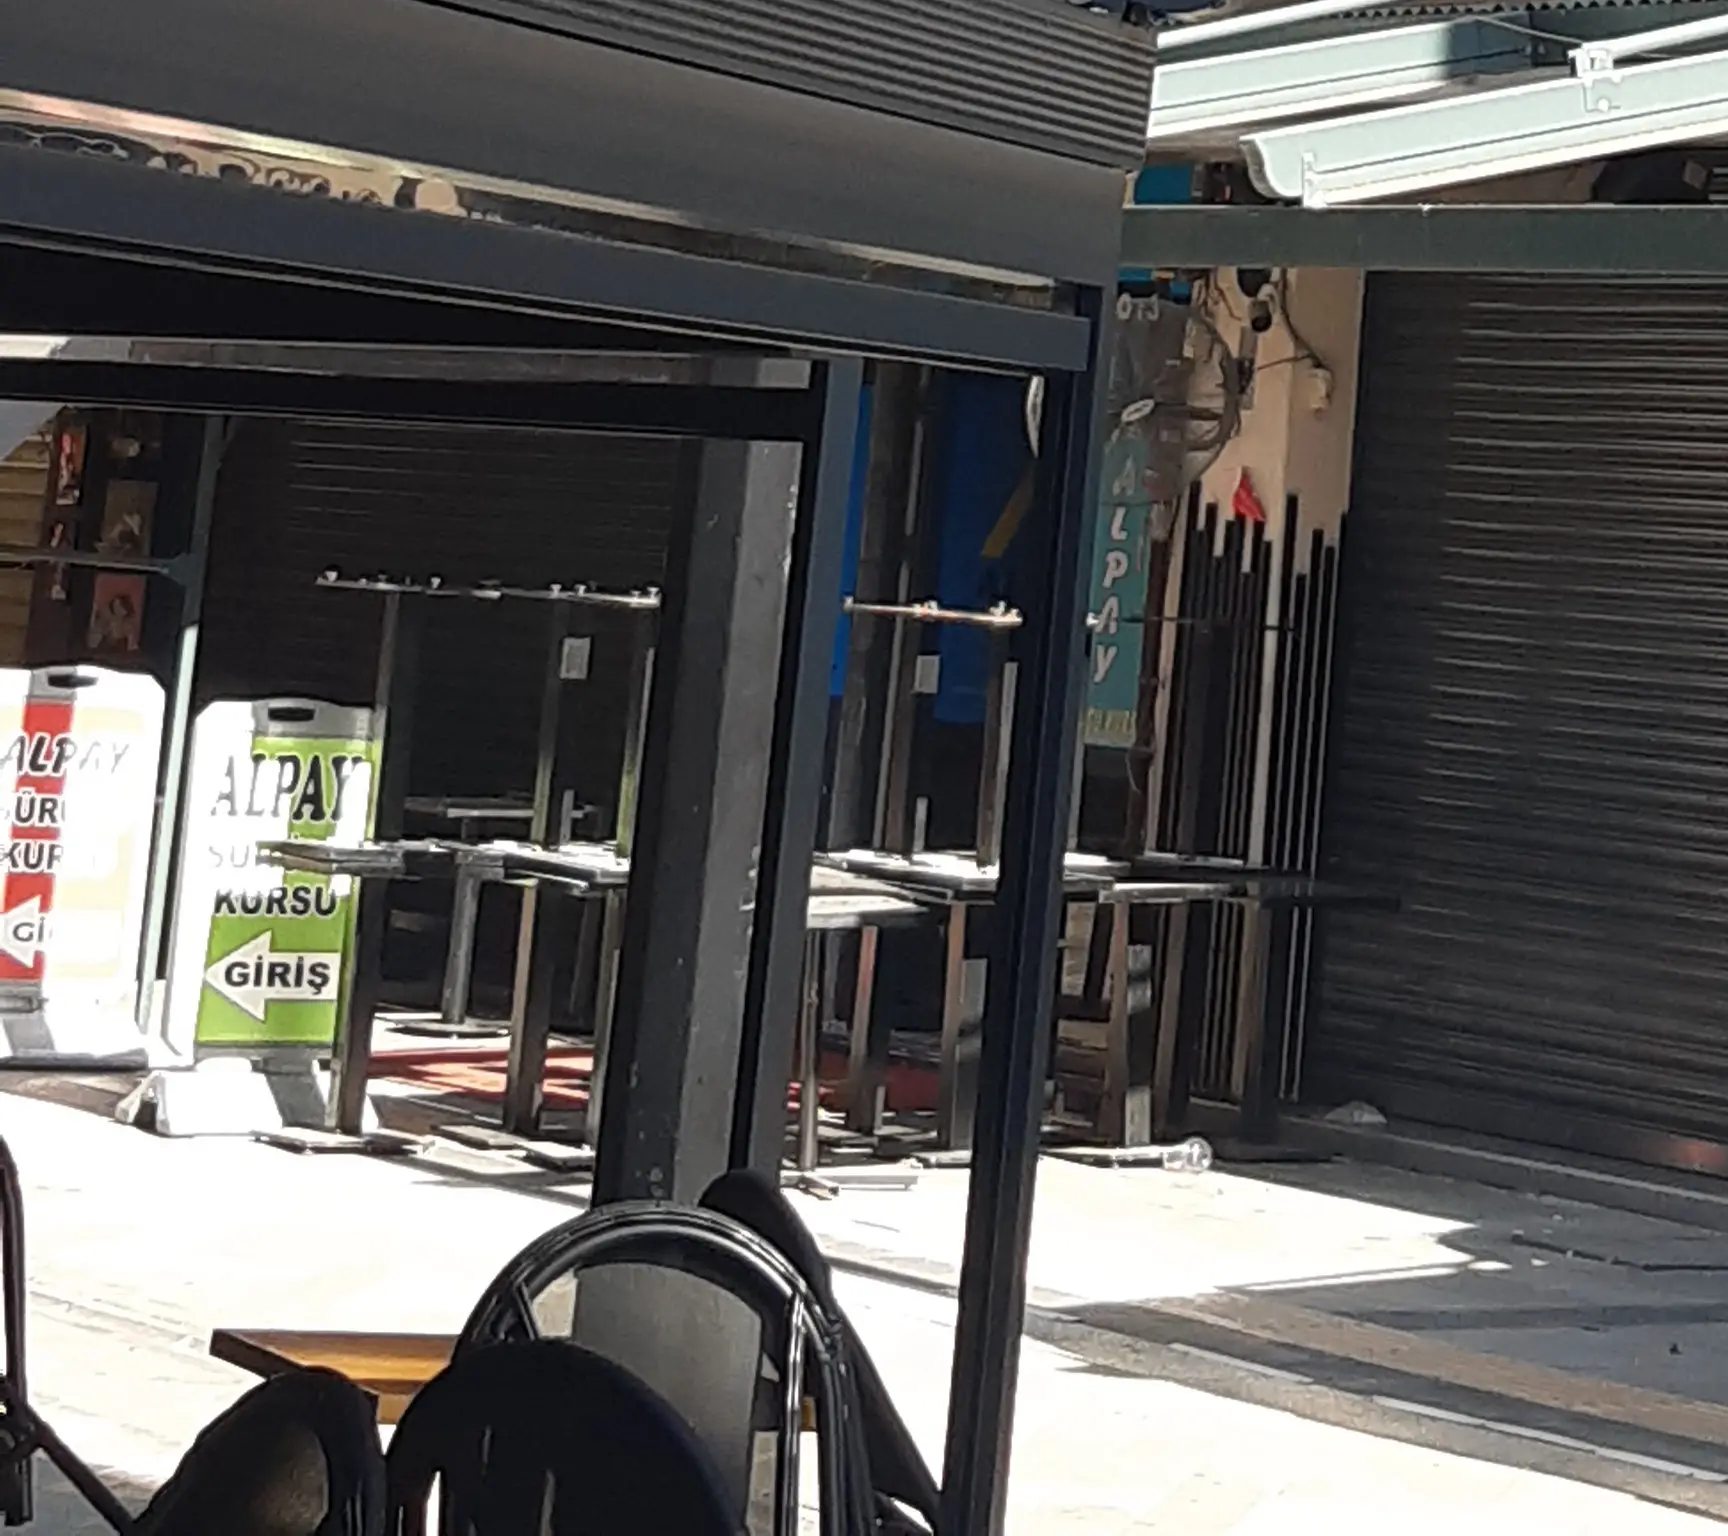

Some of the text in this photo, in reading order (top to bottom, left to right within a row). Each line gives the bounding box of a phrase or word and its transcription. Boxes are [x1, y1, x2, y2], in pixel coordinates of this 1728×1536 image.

[210, 753, 366, 821] ALPAY
[213, 885, 337, 917] KURSU
[224, 955, 331, 995] GİRİŞ
